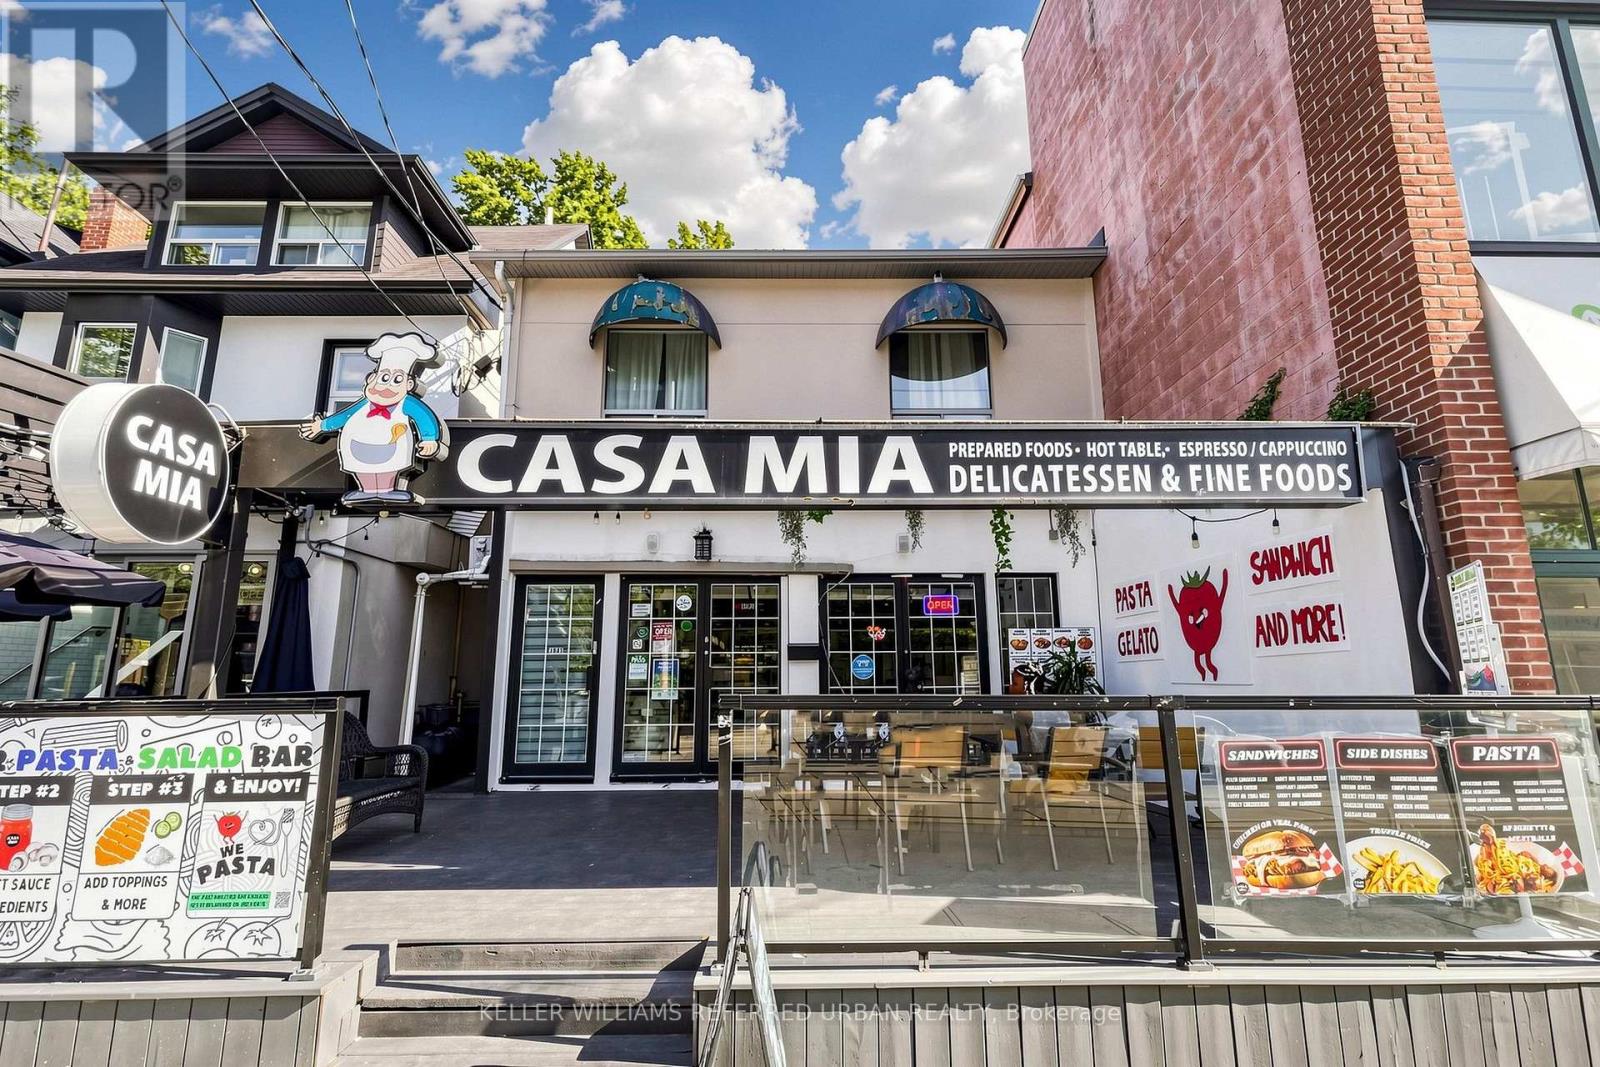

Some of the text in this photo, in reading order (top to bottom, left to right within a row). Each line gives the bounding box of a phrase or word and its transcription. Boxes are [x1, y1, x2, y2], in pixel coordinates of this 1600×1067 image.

[127, 414, 216, 476] CASA
[949, 442, 1022, 458] PREPARED
[1086, 442, 1115, 458] HOT
[456, 433, 935, 495] CASA MIA
[133, 459, 202, 511] MIA
[949, 463, 1352, 493] DELICATESSEN & FINE FOODS
[1250, 535, 1334, 586] SANDWICH
[927, 599, 954, 611] OPEN
[1115, 580, 1154, 613] PASTA
[1255, 603, 1346, 648] AND MORE!
[1117, 626, 1159, 657] GELATO
[16, 748, 119, 771] PASTA
[137, 745, 243, 769] SALAD
[252, 745, 313, 768] BAR
[1228, 749, 1319, 761] SANDWICHES
[1347, 748, 1429, 760] SIDE DISHES
[1472, 745, 1541, 761] PASTA
[0, 784, 60, 798] TEP #2
[107, 781, 183, 798] STEP #3
[214, 778, 302, 795] & ENJOY!
[220, 843, 244, 858] WE
[197, 856, 275, 885] PASTA
[11, 878, 51, 891] SAUCE
[84, 875, 168, 889] ADD TOPPINGS
[0, 901, 49, 913] EDIENTS
[101, 898, 148, 910] & MORE
